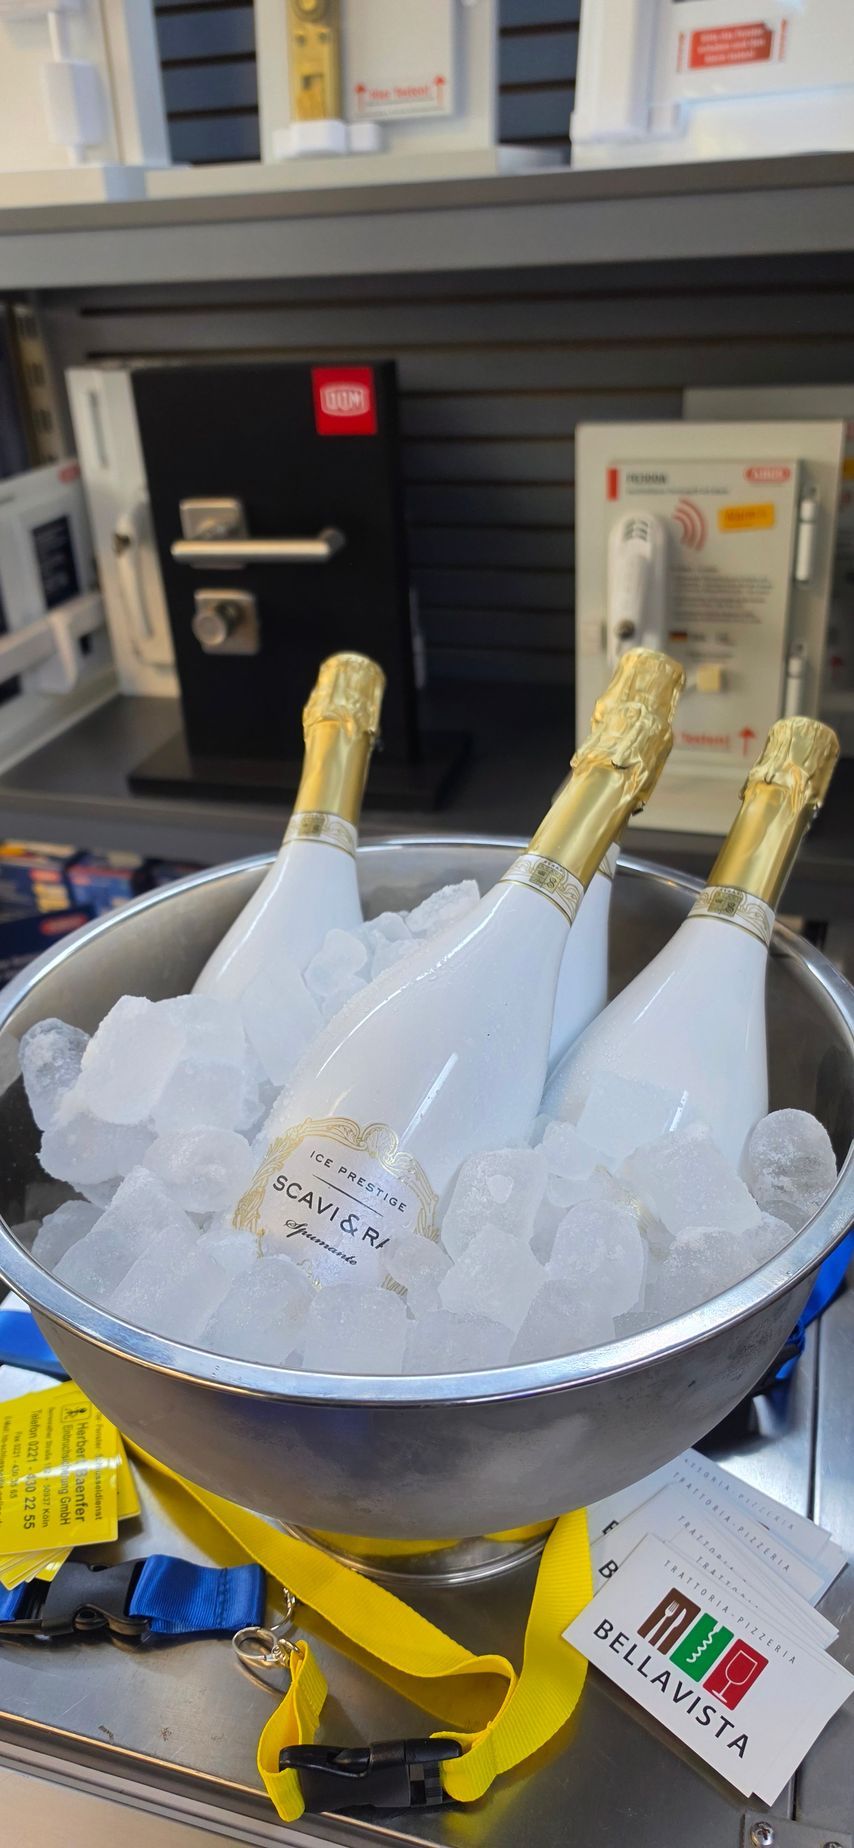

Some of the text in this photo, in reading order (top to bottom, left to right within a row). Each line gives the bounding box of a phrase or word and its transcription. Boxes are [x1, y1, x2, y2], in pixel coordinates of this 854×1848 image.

[310, 1150, 407, 1213] ICE PRESTIGE
[273, 1175, 340, 1222] SCAVI
[284, 1219, 358, 1266] Spumante
[28, 1408, 42, 1439] Telefon
[27, 1441, 39, 1462] 0221
[24, 1496, 36, 1511] 22
[42, 1508, 51, 1528] Köln
[60, 1496, 72, 1526] GmbH
[23, 1514, 36, 1530] 55
[593, 1618, 751, 1759] BELLAVISTA
